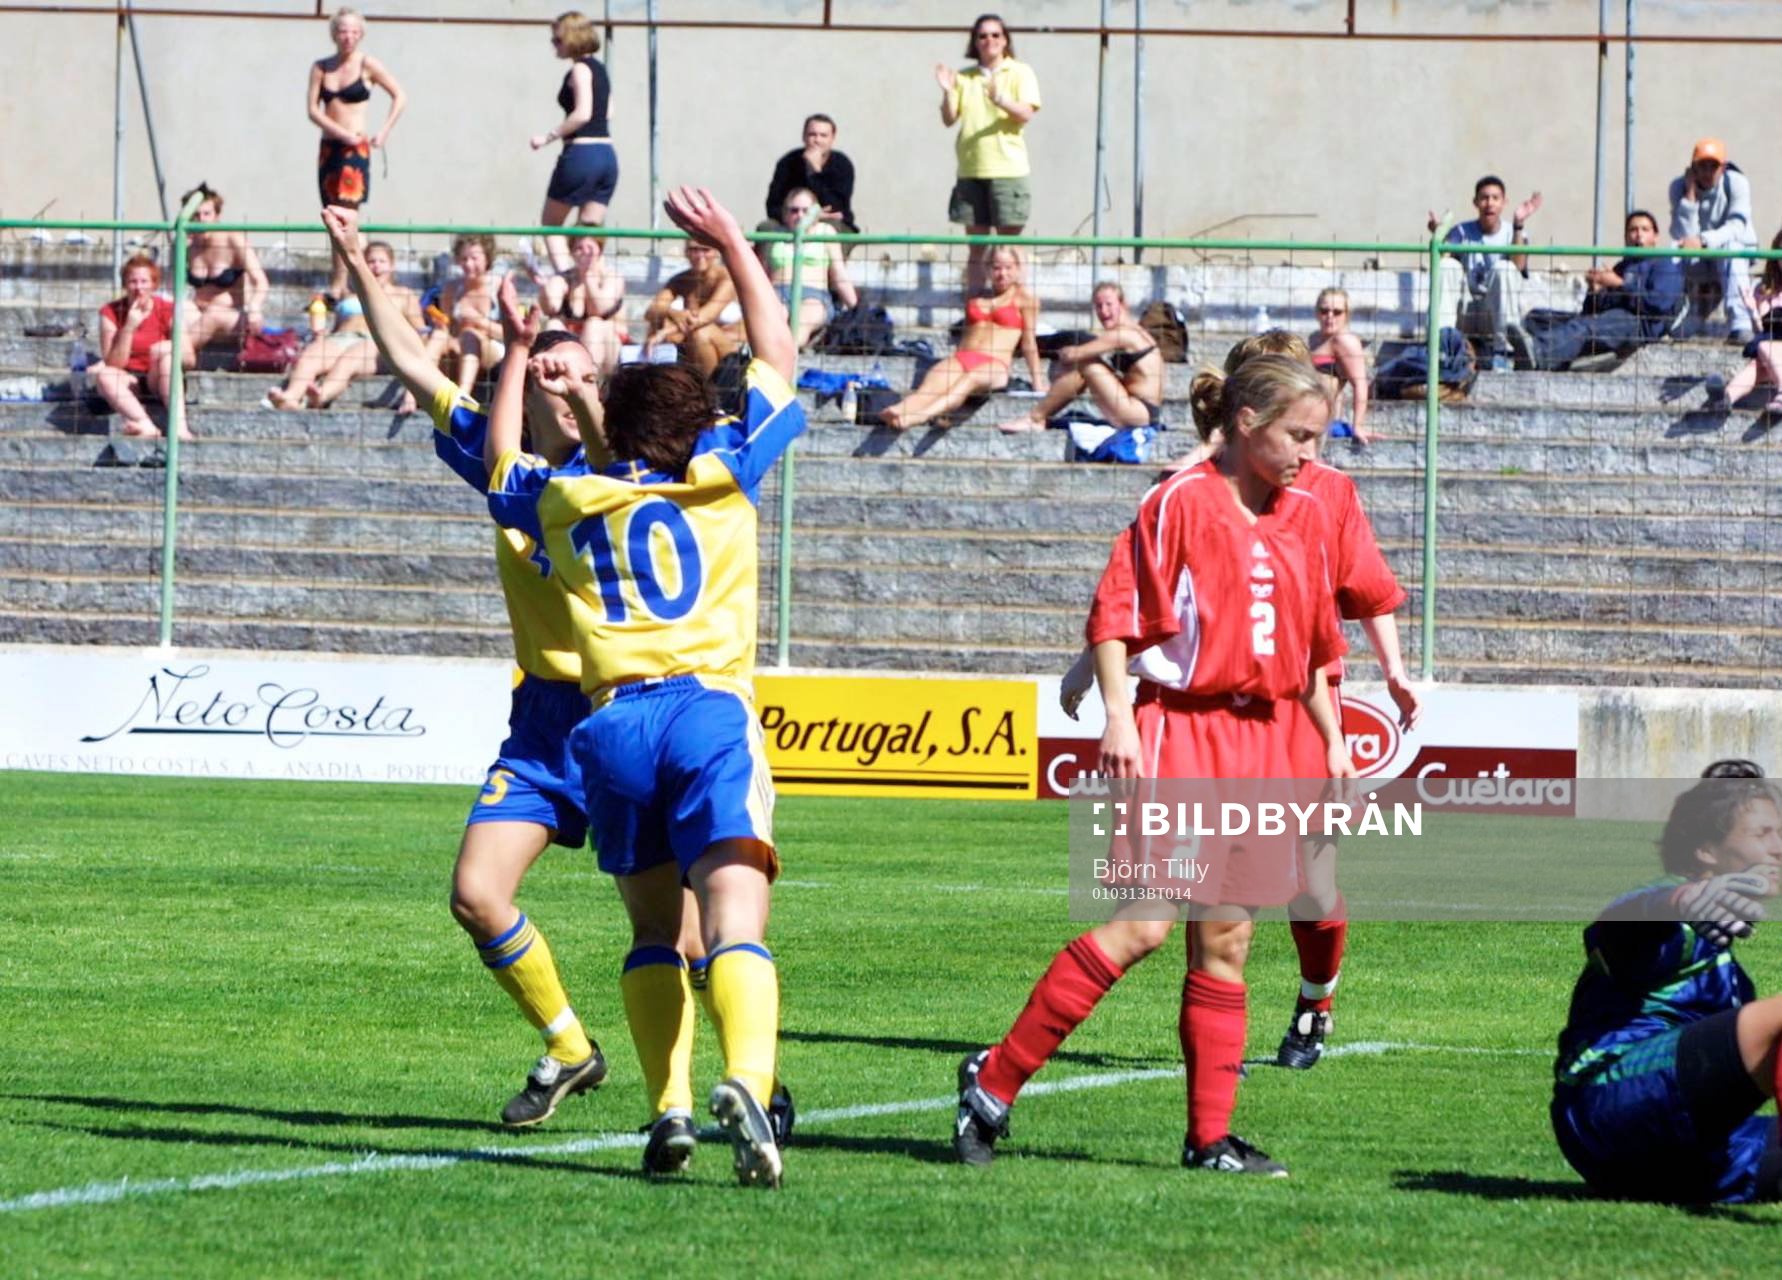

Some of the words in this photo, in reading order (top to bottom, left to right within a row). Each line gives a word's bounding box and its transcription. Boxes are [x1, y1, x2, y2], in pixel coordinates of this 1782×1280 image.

[569, 493, 707, 624] 10
[1250, 602, 1275, 656] 2
[79, 665, 254, 743] Neto
[257, 683, 426, 748] Costa
[760, 706, 938, 766] Portugal,
[947, 707, 1026, 756] S.A.
[6, 753, 69, 771] CAVES
[77, 755, 133, 773] NETO
[143, 757, 209, 775] COSTA
[386, 763, 487, 782] PORTUGA
[480, 768, 515, 805] 5
